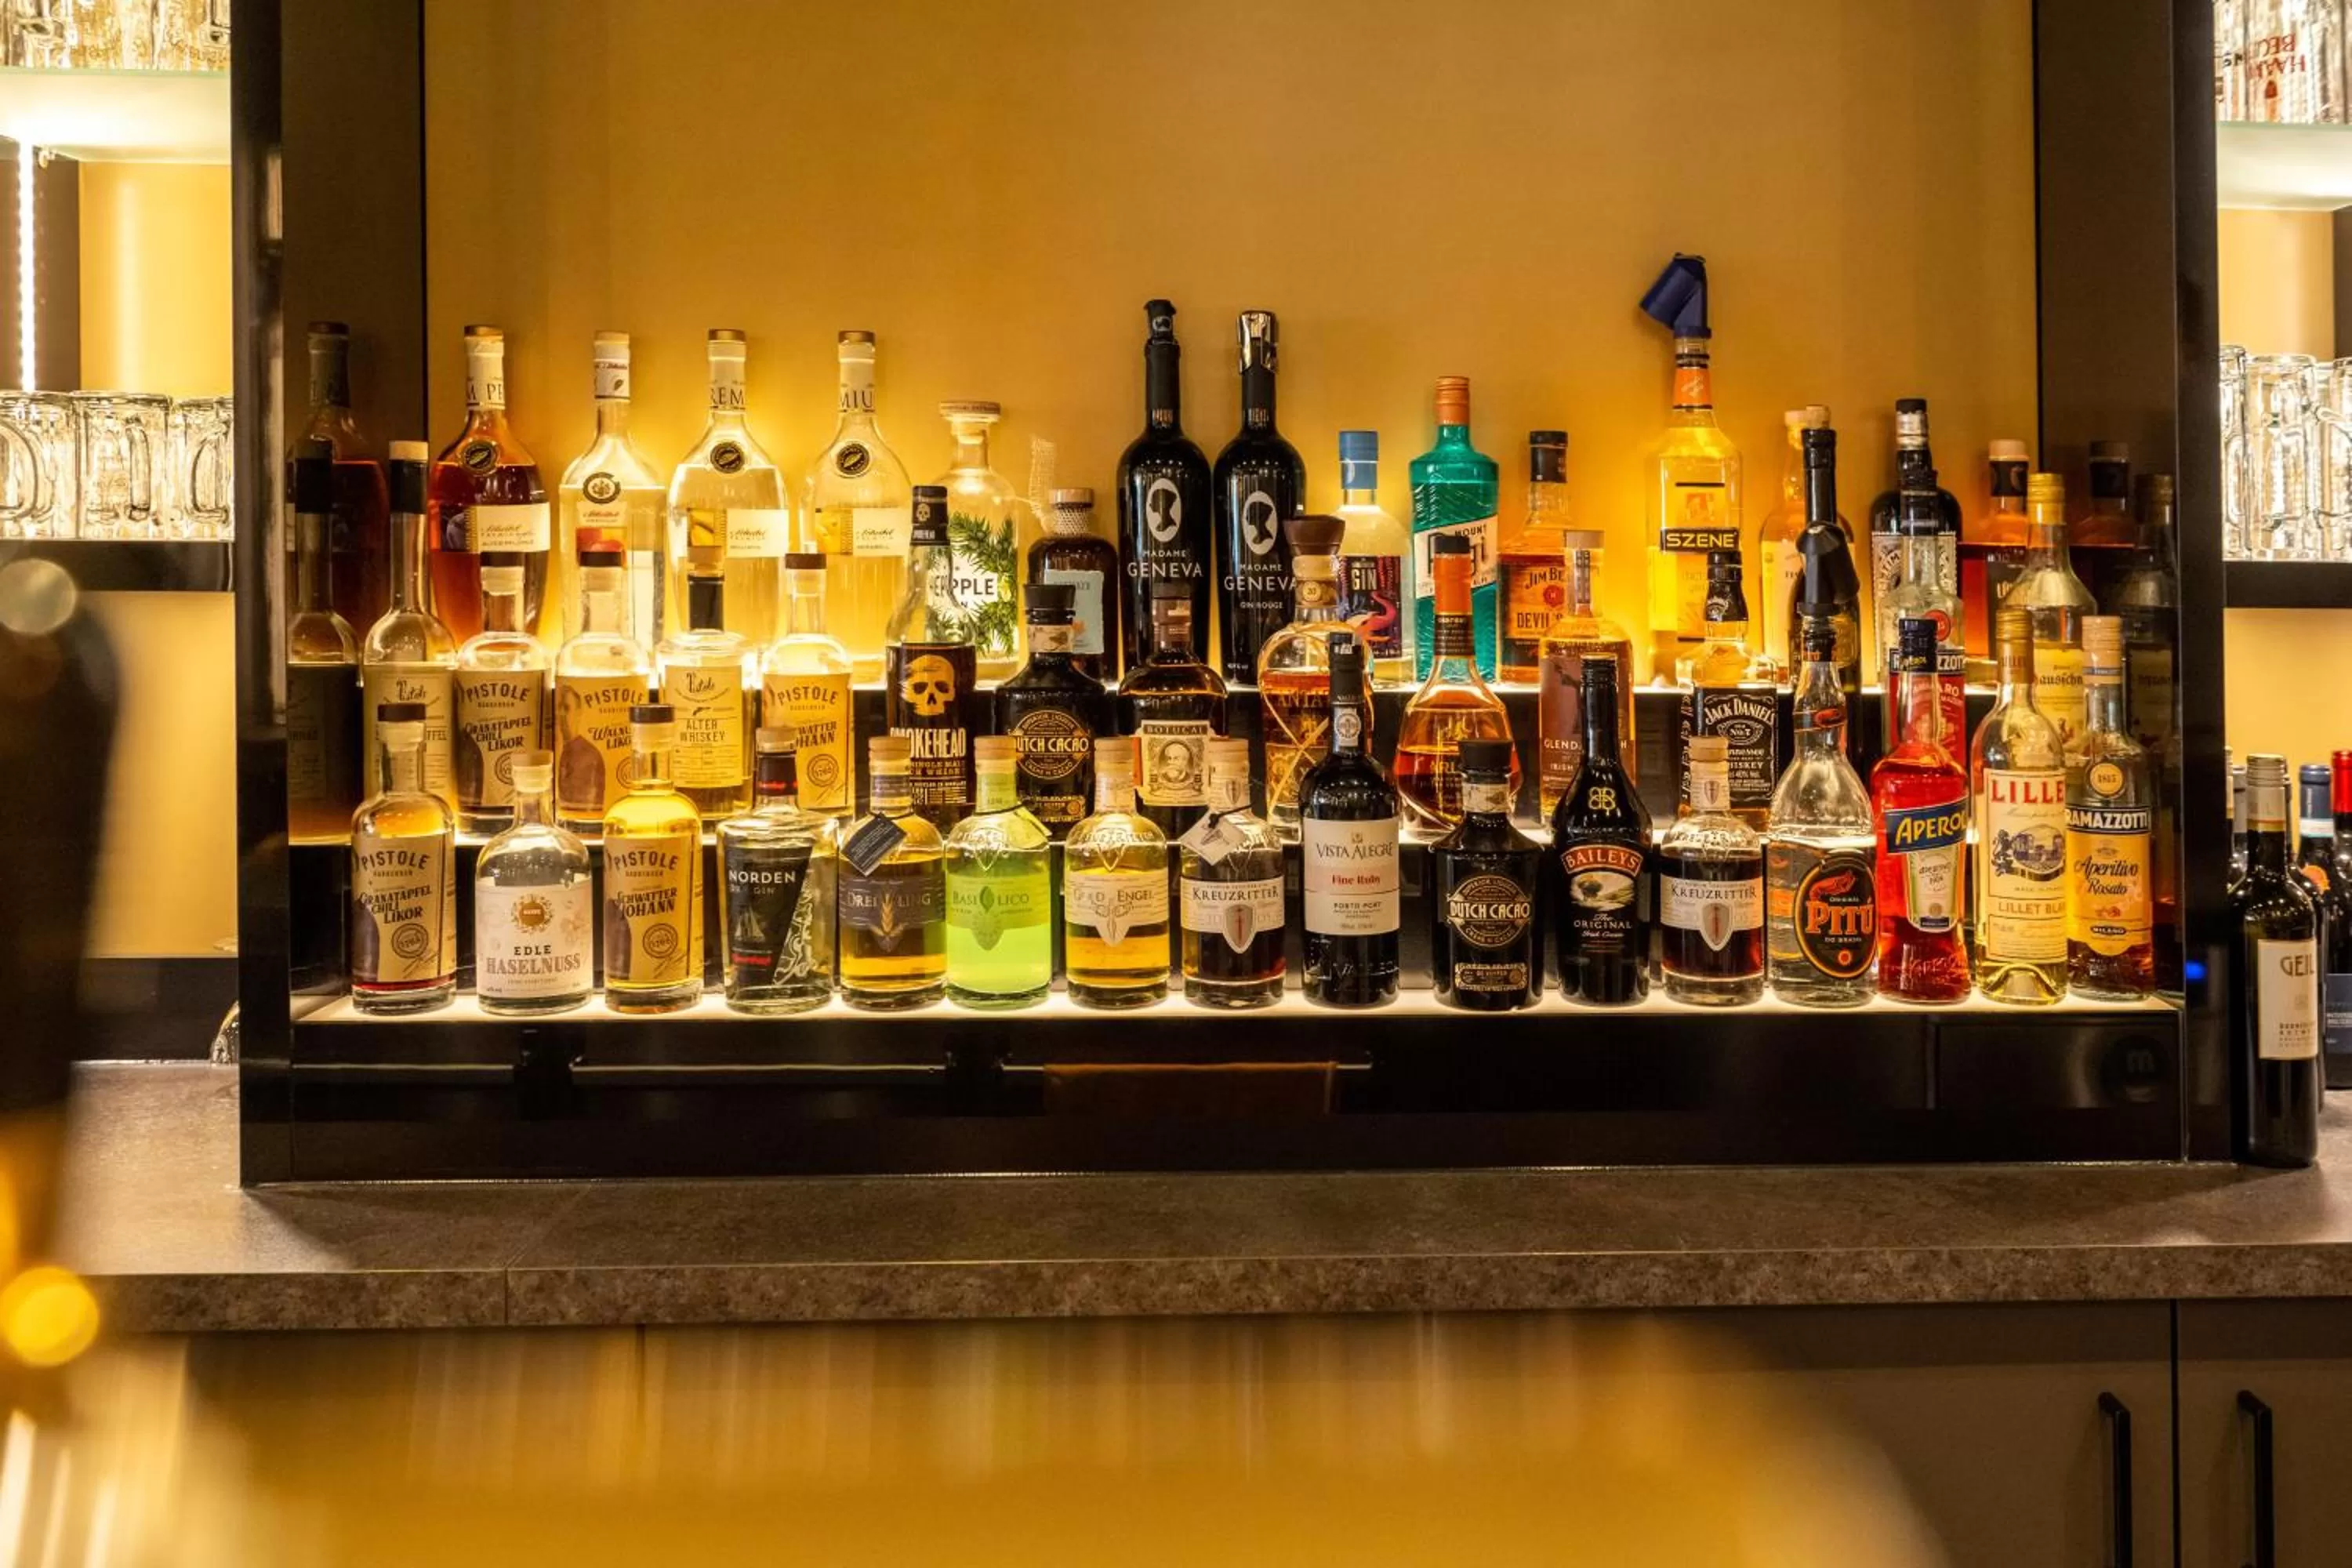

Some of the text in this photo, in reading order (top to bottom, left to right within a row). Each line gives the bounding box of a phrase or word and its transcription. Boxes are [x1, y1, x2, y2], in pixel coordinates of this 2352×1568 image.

[1455, 524, 1486, 537] MOUNT
[1666, 532, 1735, 548] SZENE
[1127, 561, 1203, 578] GENEVA
[1224, 576, 1296, 590] GENEVA
[1352, 568, 1377, 590] GIN
[1525, 567, 1565, 590] JIM BE
[466, 682, 531, 703] PISTOLE
[584, 688, 644, 708] PISTOLE
[778, 686, 838, 706] PISTOLE
[1704, 696, 1776, 725] JACK DANIEL'S
[687, 719, 717, 730] ALTER
[1147, 725, 1203, 735] BOTUCAL
[681, 731, 726, 742] WHISKEY
[1017, 738, 1089, 753] UTCH CACAO
[1991, 779, 2065, 804] LILLE
[1896, 811, 1967, 846] APEROL
[2066, 811, 2149, 829] RAMAZZOTTI
[1316, 841, 1393, 860] VISTA ALEGRE
[1566, 849, 1639, 869] BAILEYS
[361, 851, 430, 871] PISTOLE
[615, 851, 678, 872] PISTOLE
[2074, 855, 2139, 879] Aperitivo
[728, 870, 796, 884] NORDEN
[1332, 875, 1355, 885] Fine
[359, 884, 432, 904] GRANATAPFEL
[1192, 887, 1279, 901] KREUZRITTER
[1671, 884, 1757, 899] KREUZRITTER
[2087, 878, 2128, 895] Rosato
[617, 887, 677, 905] SCHWATTER
[1117, 890, 1155, 902] ENGEL
[371, 900, 399, 914] CHILI
[621, 900, 675, 920] JOHANN
[1450, 902, 1530, 918] DUTCH CACAO
[1998, 902, 2066, 915] LILLET BLA
[1573, 920, 1633, 929] ORIGINAL
[514, 945, 552, 956] EDLE
[486, 953, 581, 975] HASELNUSS
[2280, 953, 2314, 977] GEIL
